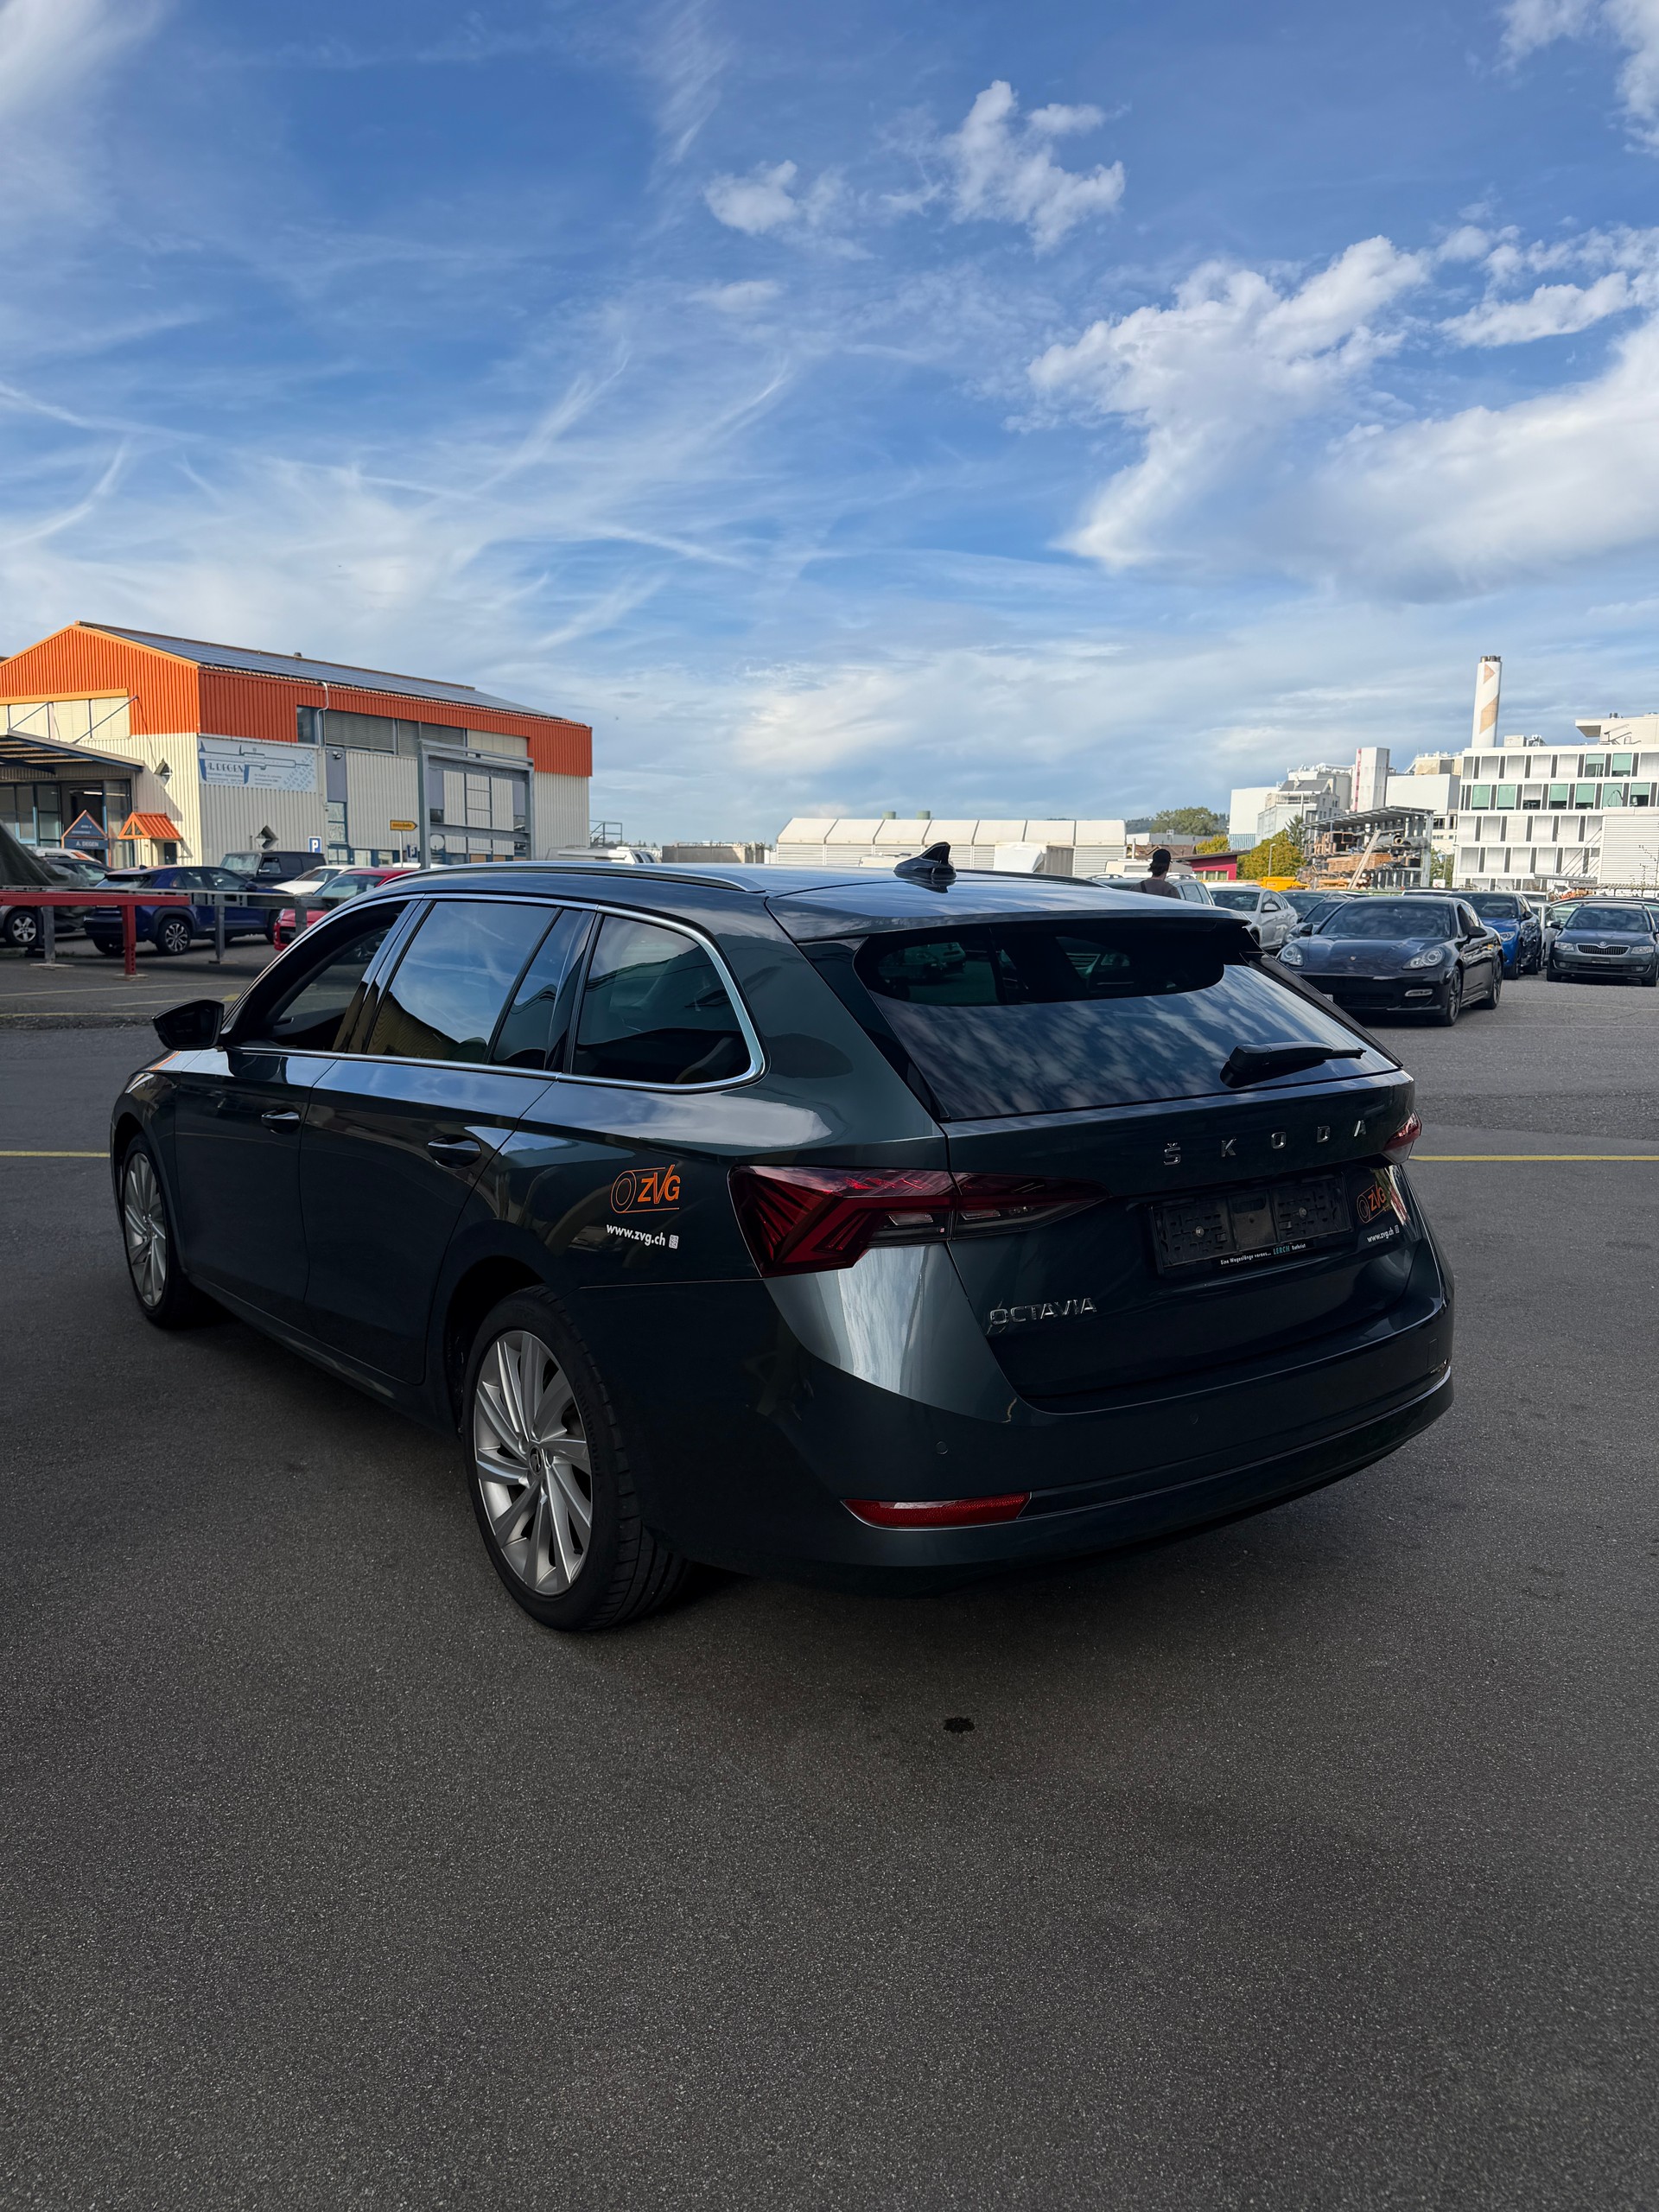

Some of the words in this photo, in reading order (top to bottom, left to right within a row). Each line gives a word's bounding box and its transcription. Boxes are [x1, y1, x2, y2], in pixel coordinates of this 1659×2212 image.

[216, 763, 244, 772] DEGEN
[312, 839, 319, 852] P
[1163, 1119, 1368, 1166] ŠKODA
[637, 1164, 681, 1205] ZVG
[1368, 1181, 1386, 1211] ZVG
[606, 1224, 665, 1247] www.zvg.ch
[1366, 1226, 1394, 1243] www.zvg.ch
[1273, 1245, 1291, 1255] LERCH
[989, 1297, 1097, 1325] OCTAVIA
